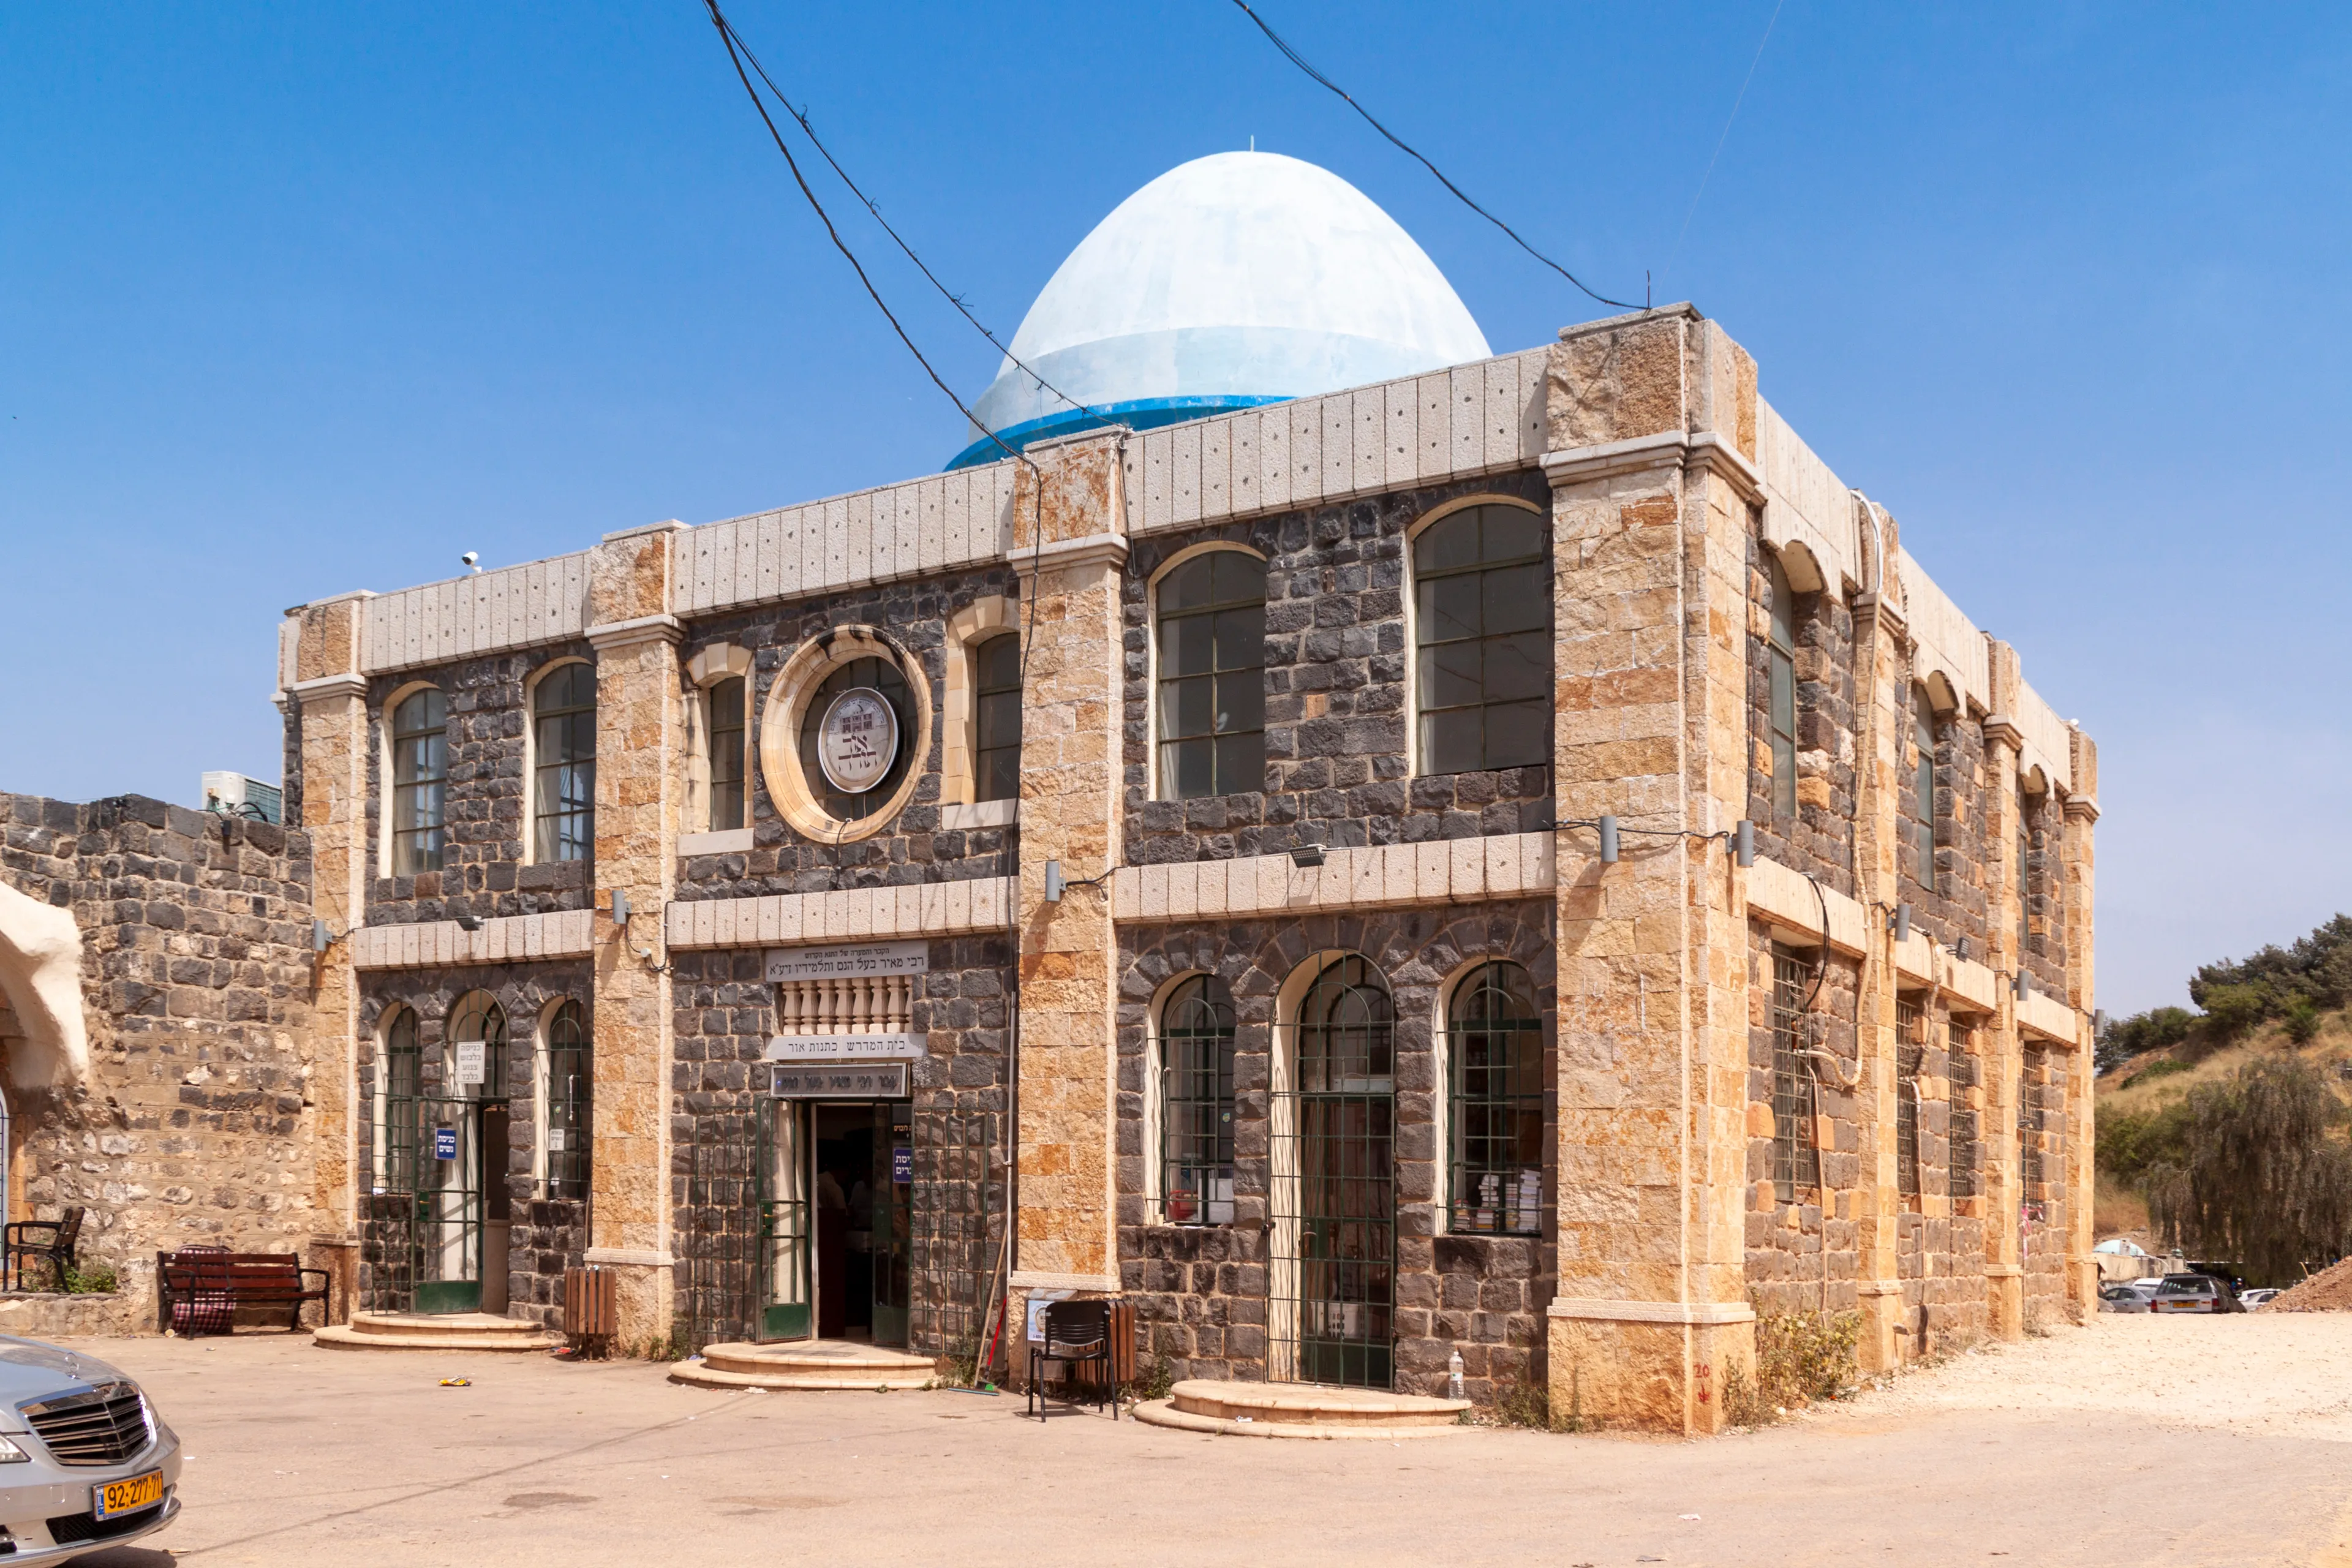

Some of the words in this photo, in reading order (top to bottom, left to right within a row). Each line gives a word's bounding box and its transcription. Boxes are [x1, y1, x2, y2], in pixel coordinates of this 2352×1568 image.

[795, 959, 834, 974] ותלמידיו
[837, 960, 853, 971] הנס
[857, 957, 876, 971] בעל
[880, 958, 903, 968] מאיר
[907, 956, 924, 967] רבי
[788, 1042, 805, 1052] אור
[809, 1042, 838, 1052] כתנות
[846, 1041, 883, 1051] המדרש
[887, 1039, 905, 1051] בית
[460, 1052, 481, 1061] בלבוש
[805, 1072, 824, 1088] בעל
[829, 1075, 851, 1088] מאיר
